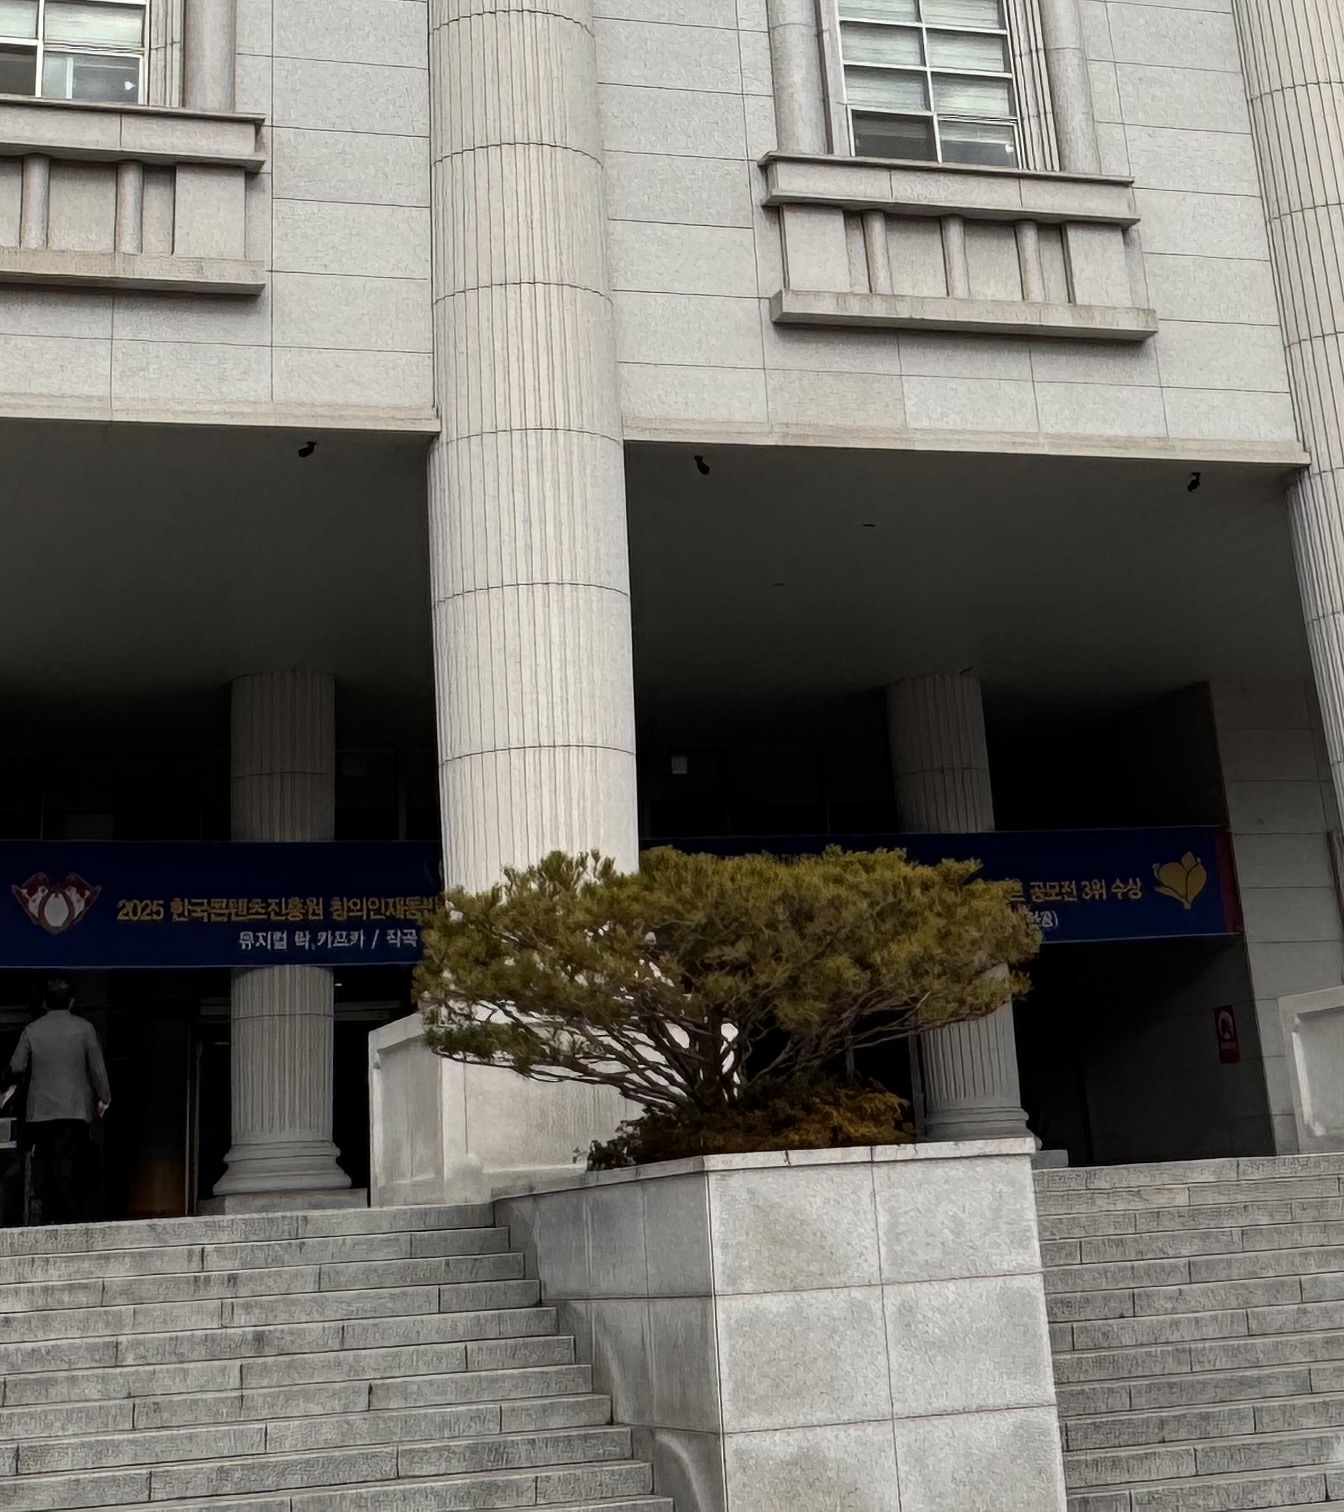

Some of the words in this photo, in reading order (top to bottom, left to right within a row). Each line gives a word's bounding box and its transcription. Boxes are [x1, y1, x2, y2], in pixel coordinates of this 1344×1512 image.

[116, 898, 165, 921] 2025
[170, 896, 324, 922] 한국콘텐츠진흥원
[1029, 879, 1078, 902] 공모전
[1081, 878, 1107, 901] 3위
[1111, 877, 1143, 900] 수상
[239, 929, 287, 951] 뮤지컬
[371, 928, 380, 949] /
[386, 928, 418, 948] 작곡
